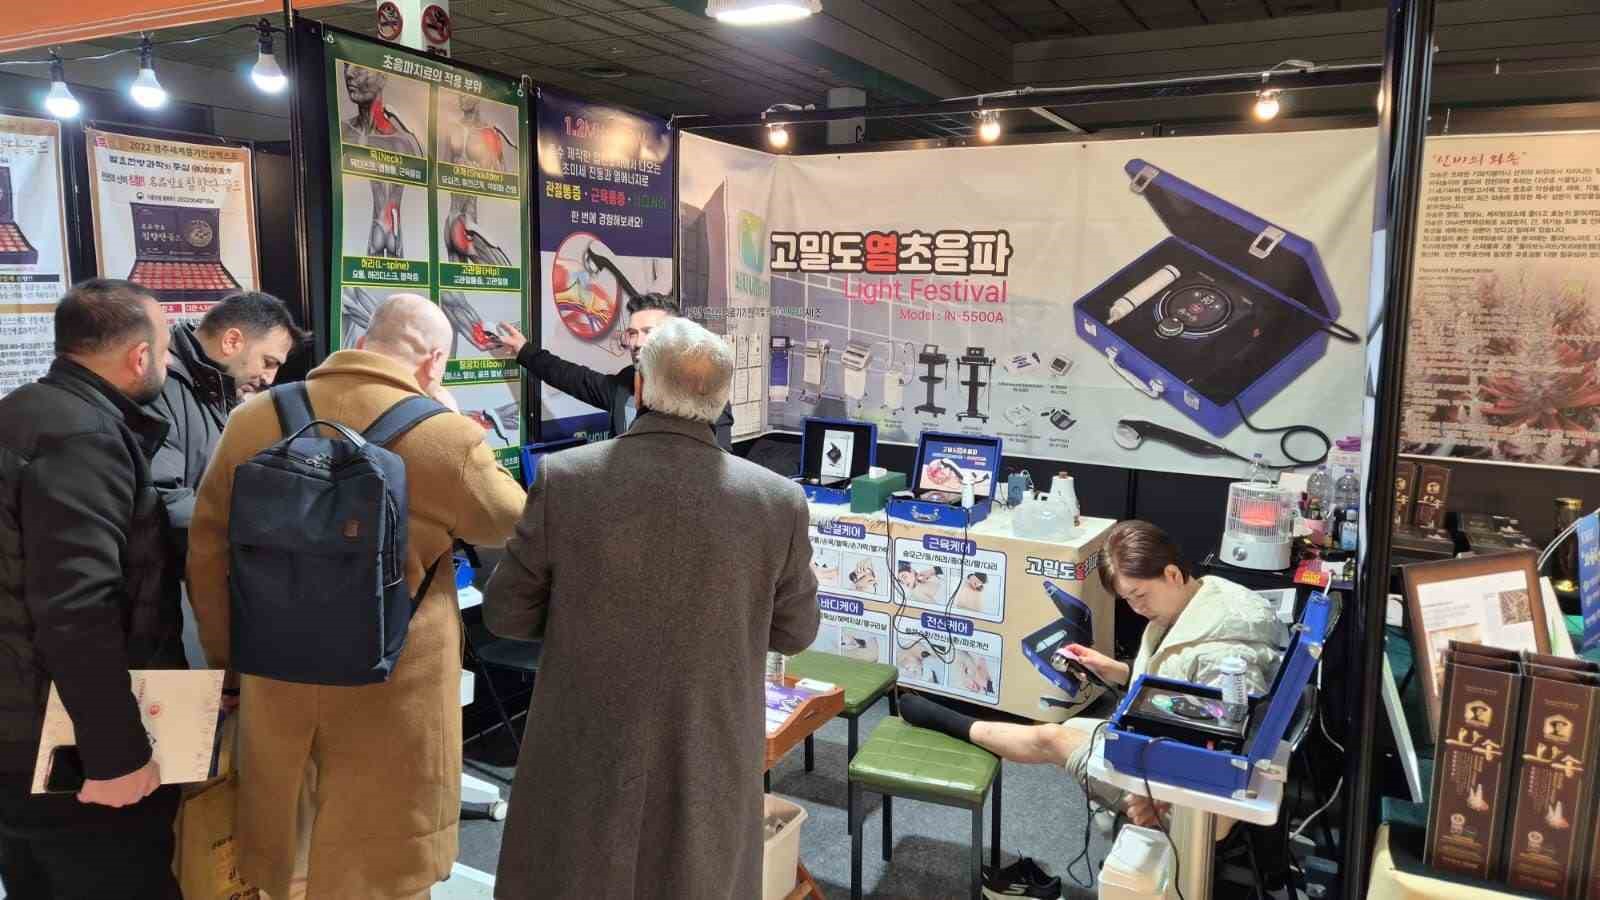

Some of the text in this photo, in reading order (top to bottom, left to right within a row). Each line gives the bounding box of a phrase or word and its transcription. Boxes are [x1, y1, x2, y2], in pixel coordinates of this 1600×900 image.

[545, 180, 581, 201] 관절통증
[770, 230, 1014, 276] 고밀도열초음파
[843, 278, 1007, 306] Light Festival
[900, 309, 934, 321] Model
[927, 538, 971, 555] 근육케어
[820, 599, 859, 615] 바디케어
[926, 616, 969, 634] 전신케어
